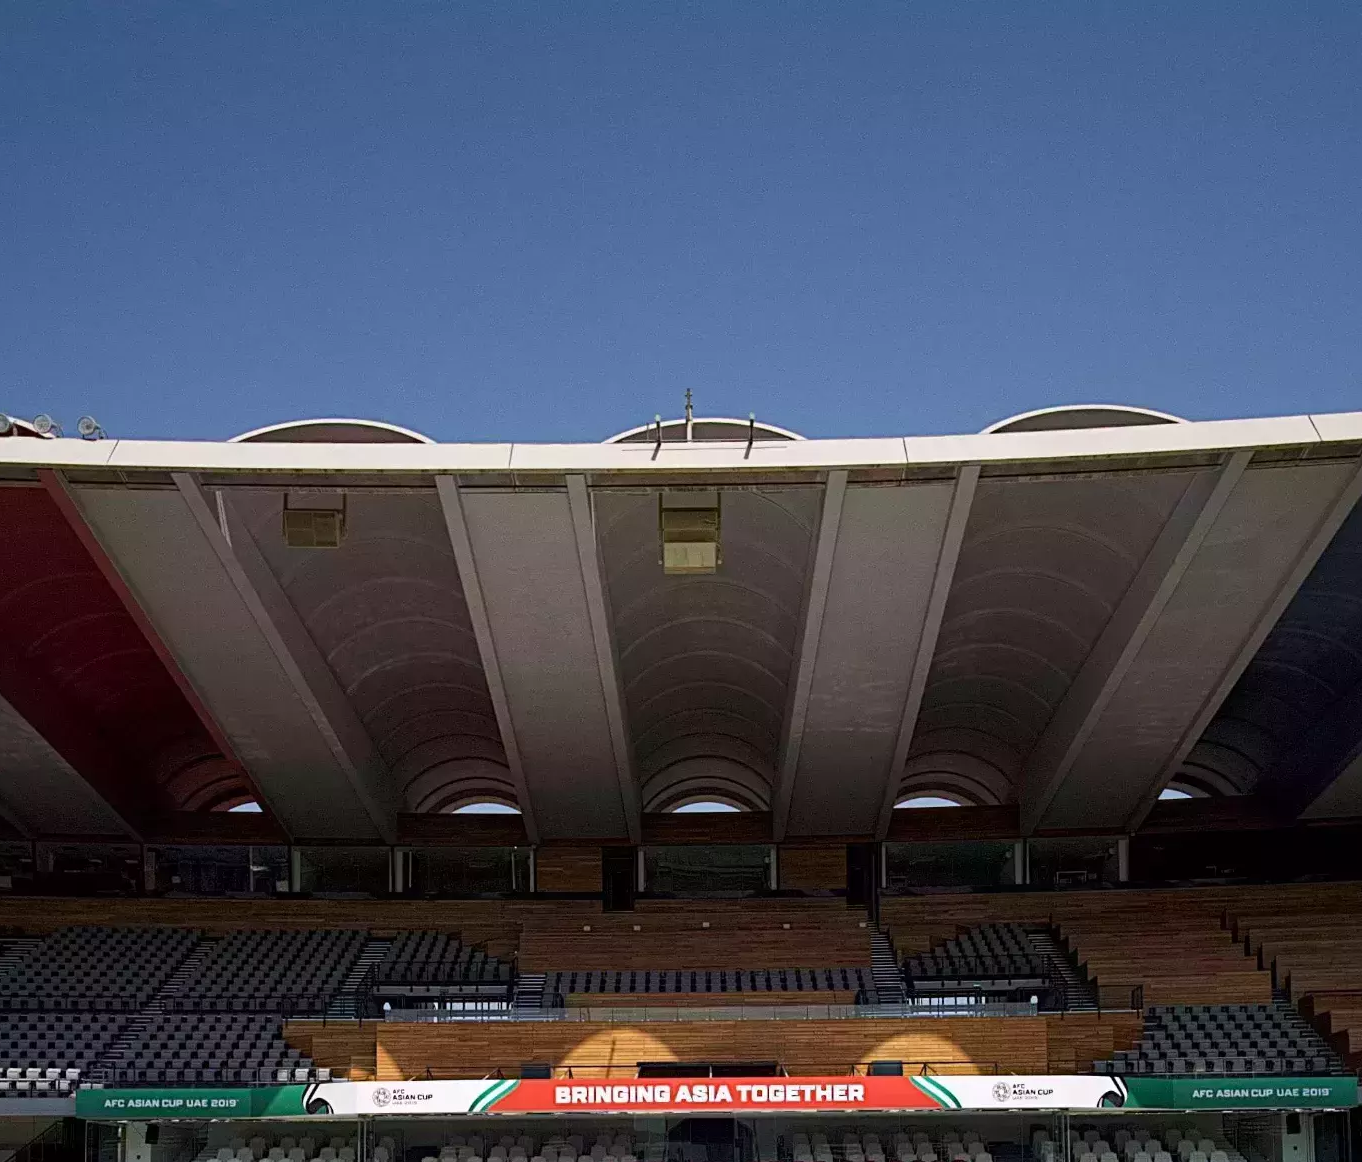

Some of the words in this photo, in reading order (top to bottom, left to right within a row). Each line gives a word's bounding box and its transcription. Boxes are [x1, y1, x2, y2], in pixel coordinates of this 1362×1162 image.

[556, 1085, 670, 1103] BRINGING
[675, 1085, 733, 1102] ASIA
[736, 1084, 864, 1102] TOGETHER
[1193, 1090, 1213, 1098] AFC
[1216, 1089, 1250, 1098] ASIAN
[1251, 1089, 1273, 1097] CUP
[1277, 1088, 1299, 1097] UAE
[104, 1099, 124, 1107] AFC
[128, 1099, 159, 1107] ASIAN
[162, 1099, 183, 1107] CUP
[186, 1099, 208, 1107] UAE
